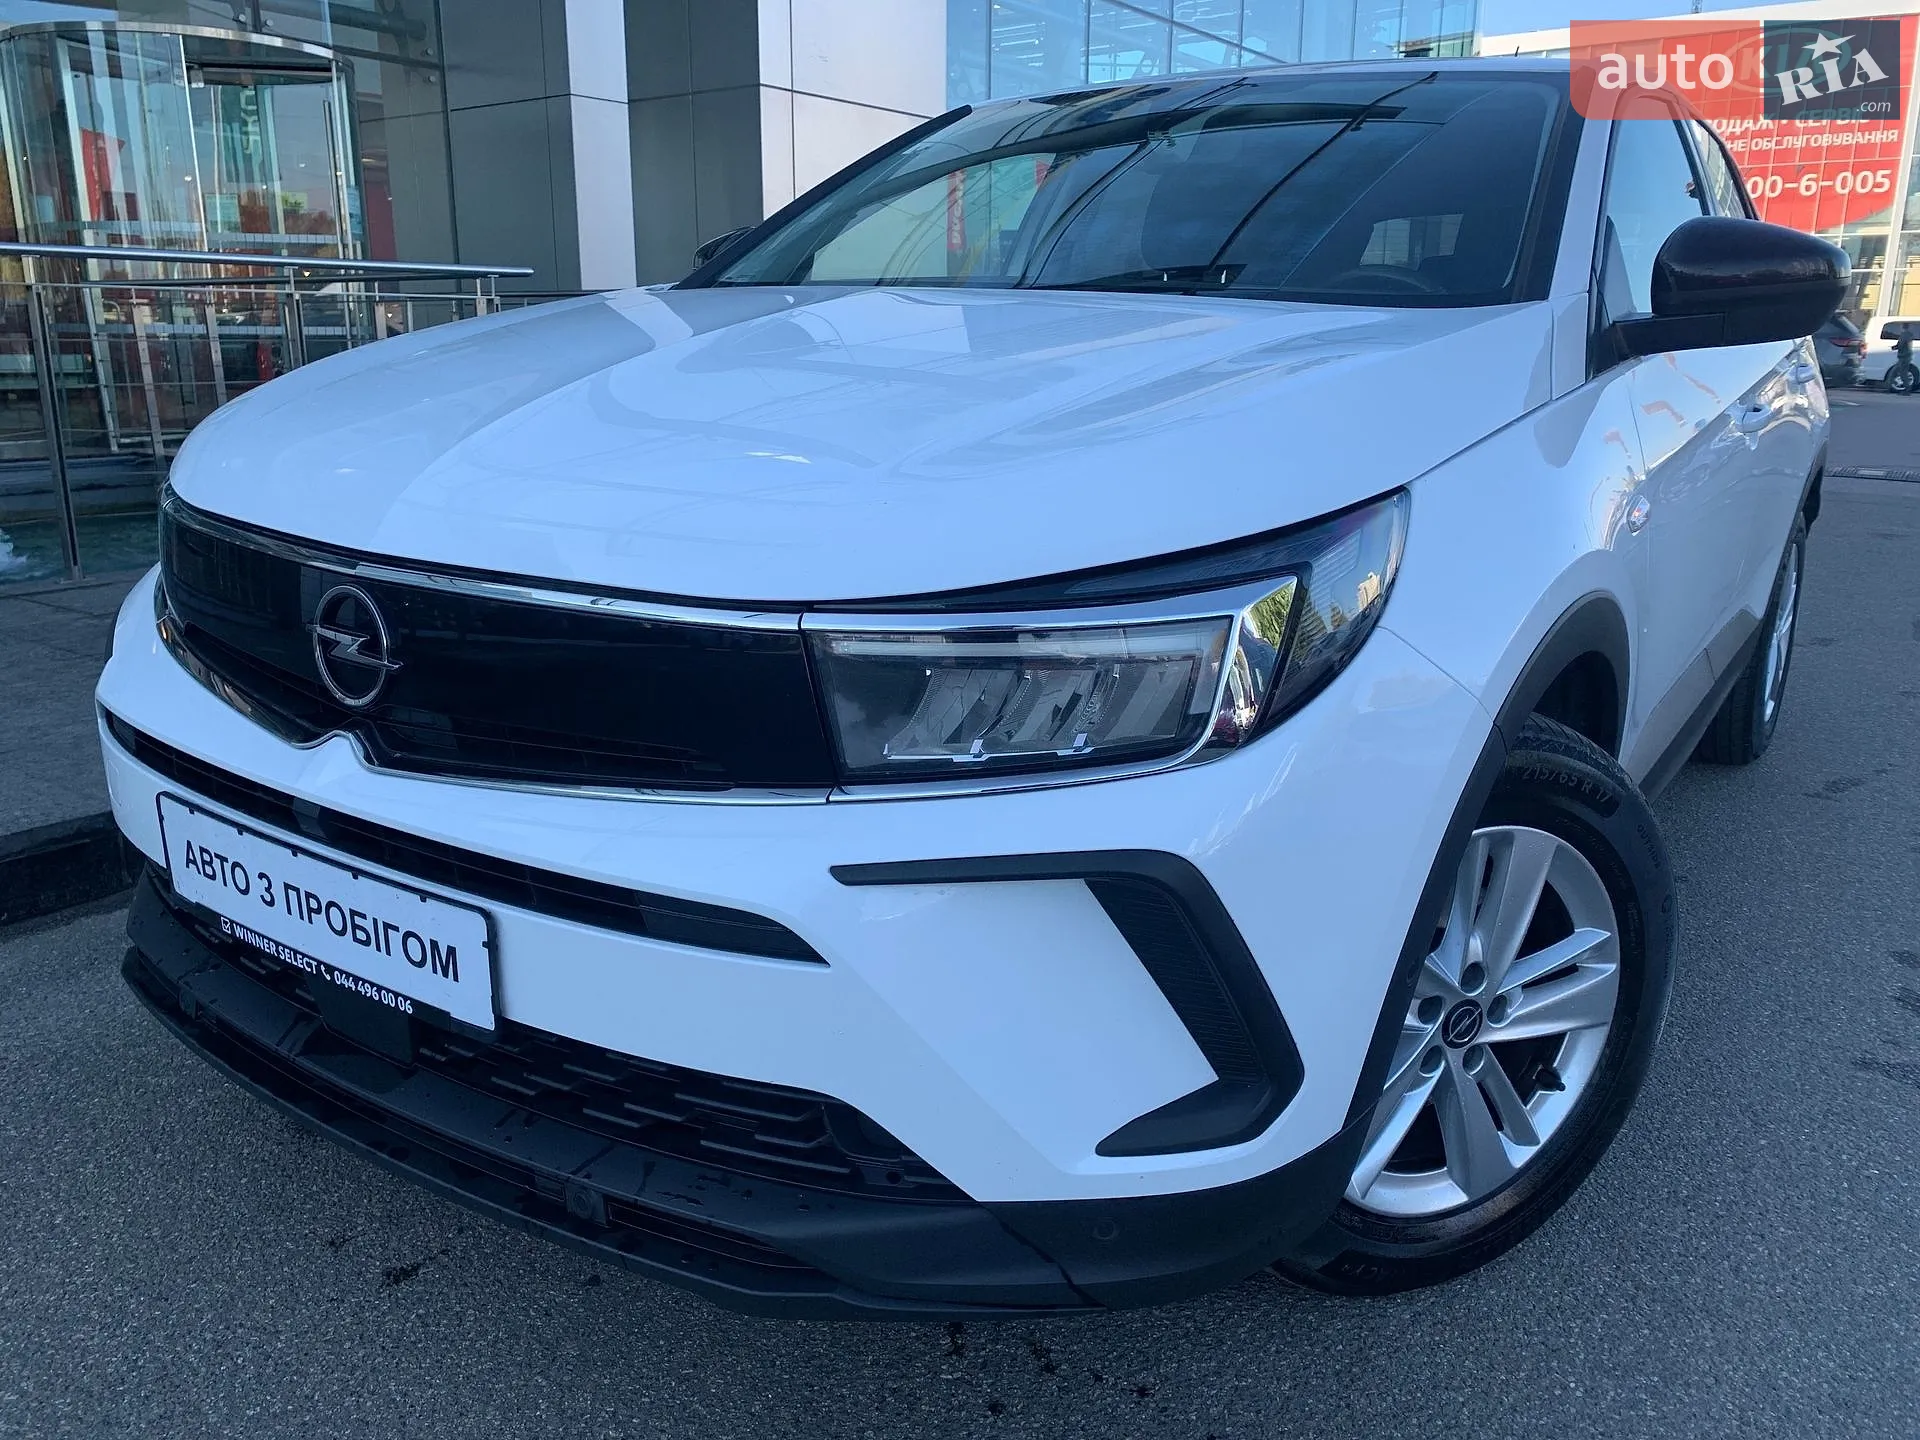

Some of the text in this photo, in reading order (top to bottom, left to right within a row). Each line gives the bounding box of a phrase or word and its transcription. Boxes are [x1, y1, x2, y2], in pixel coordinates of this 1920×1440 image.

[1707, 112, 1776, 136] ОДАЖ
[1725, 129, 1899, 153] НЕ ОБСЛУГОВУВАННЯ
[1746, 169, 1892, 199] 00-6-005
[1594, 786, 1613, 803] 17
[185, 839, 460, 983] АВТО З ПРОБІГОМ
[233, 923, 413, 1014] WINNER SELECT 044 496 00 06
